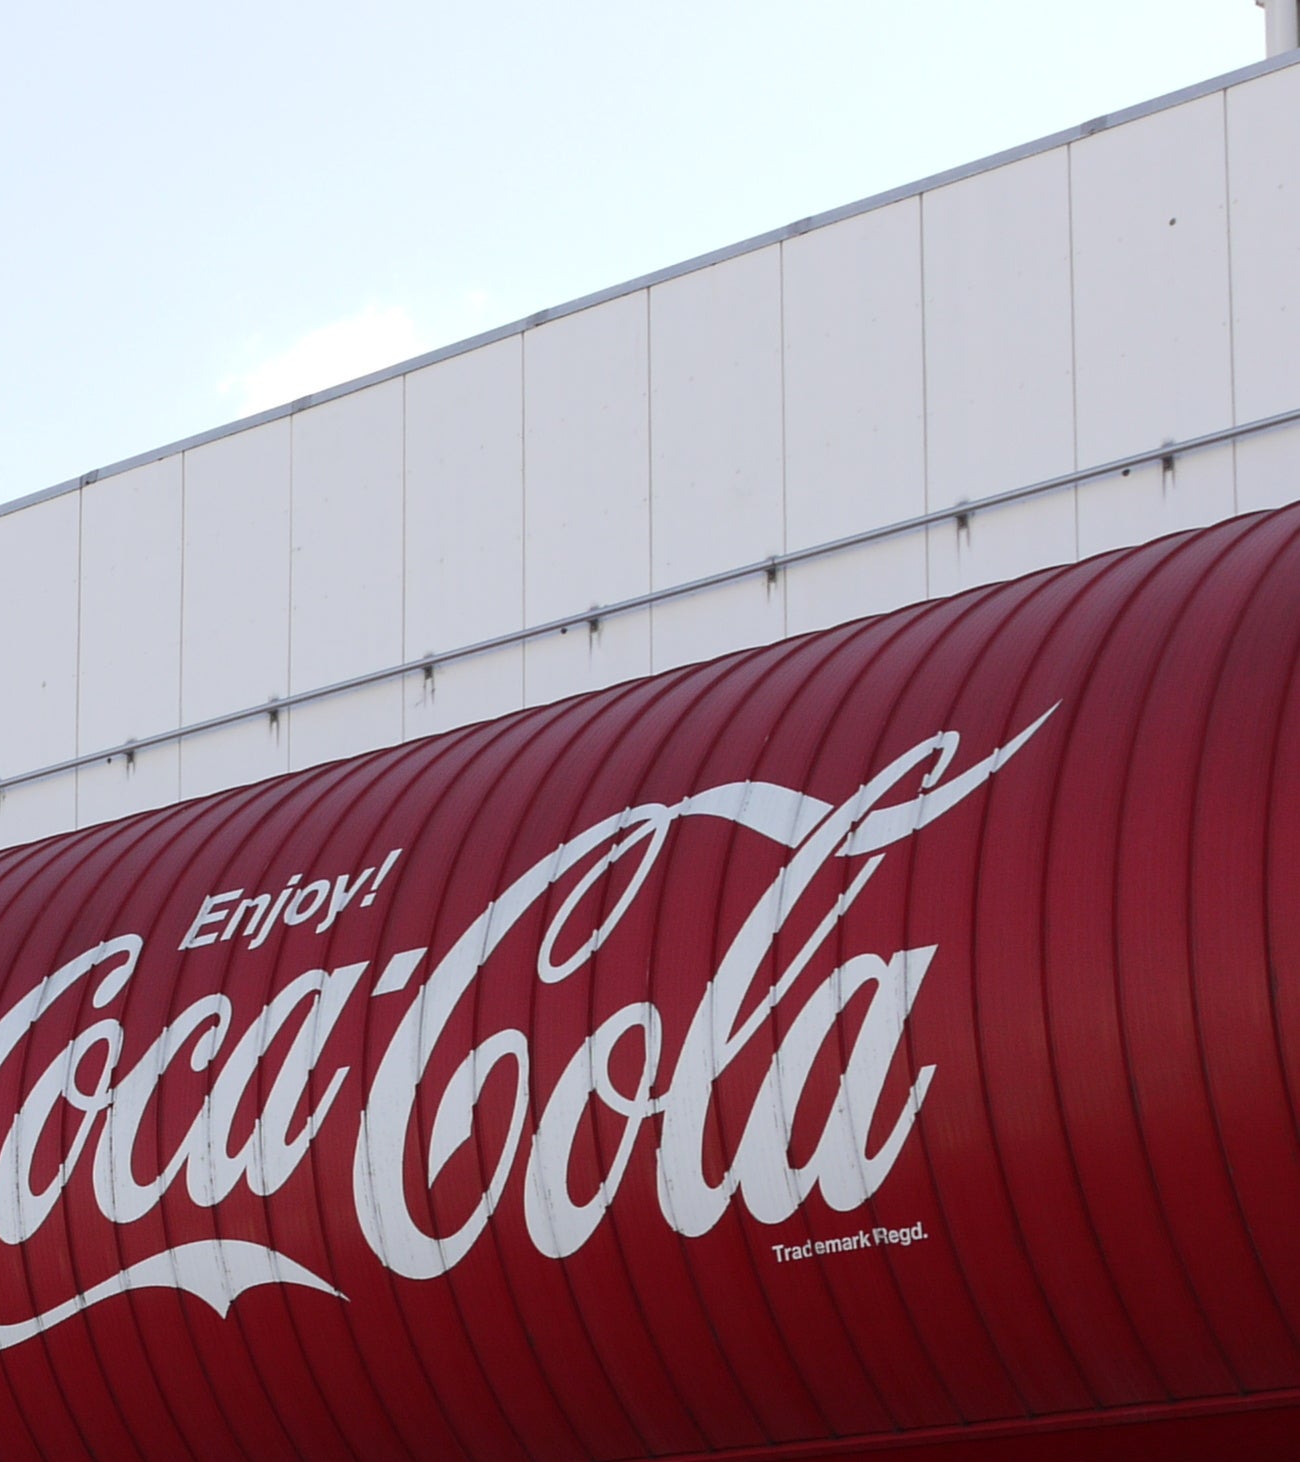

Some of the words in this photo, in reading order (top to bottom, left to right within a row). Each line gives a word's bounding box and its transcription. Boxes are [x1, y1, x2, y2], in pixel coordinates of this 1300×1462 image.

[178, 848, 403, 951] Enjoy!
[772, 1230, 871, 1263] Trademark
[872, 1221, 929, 1247] Regd.
